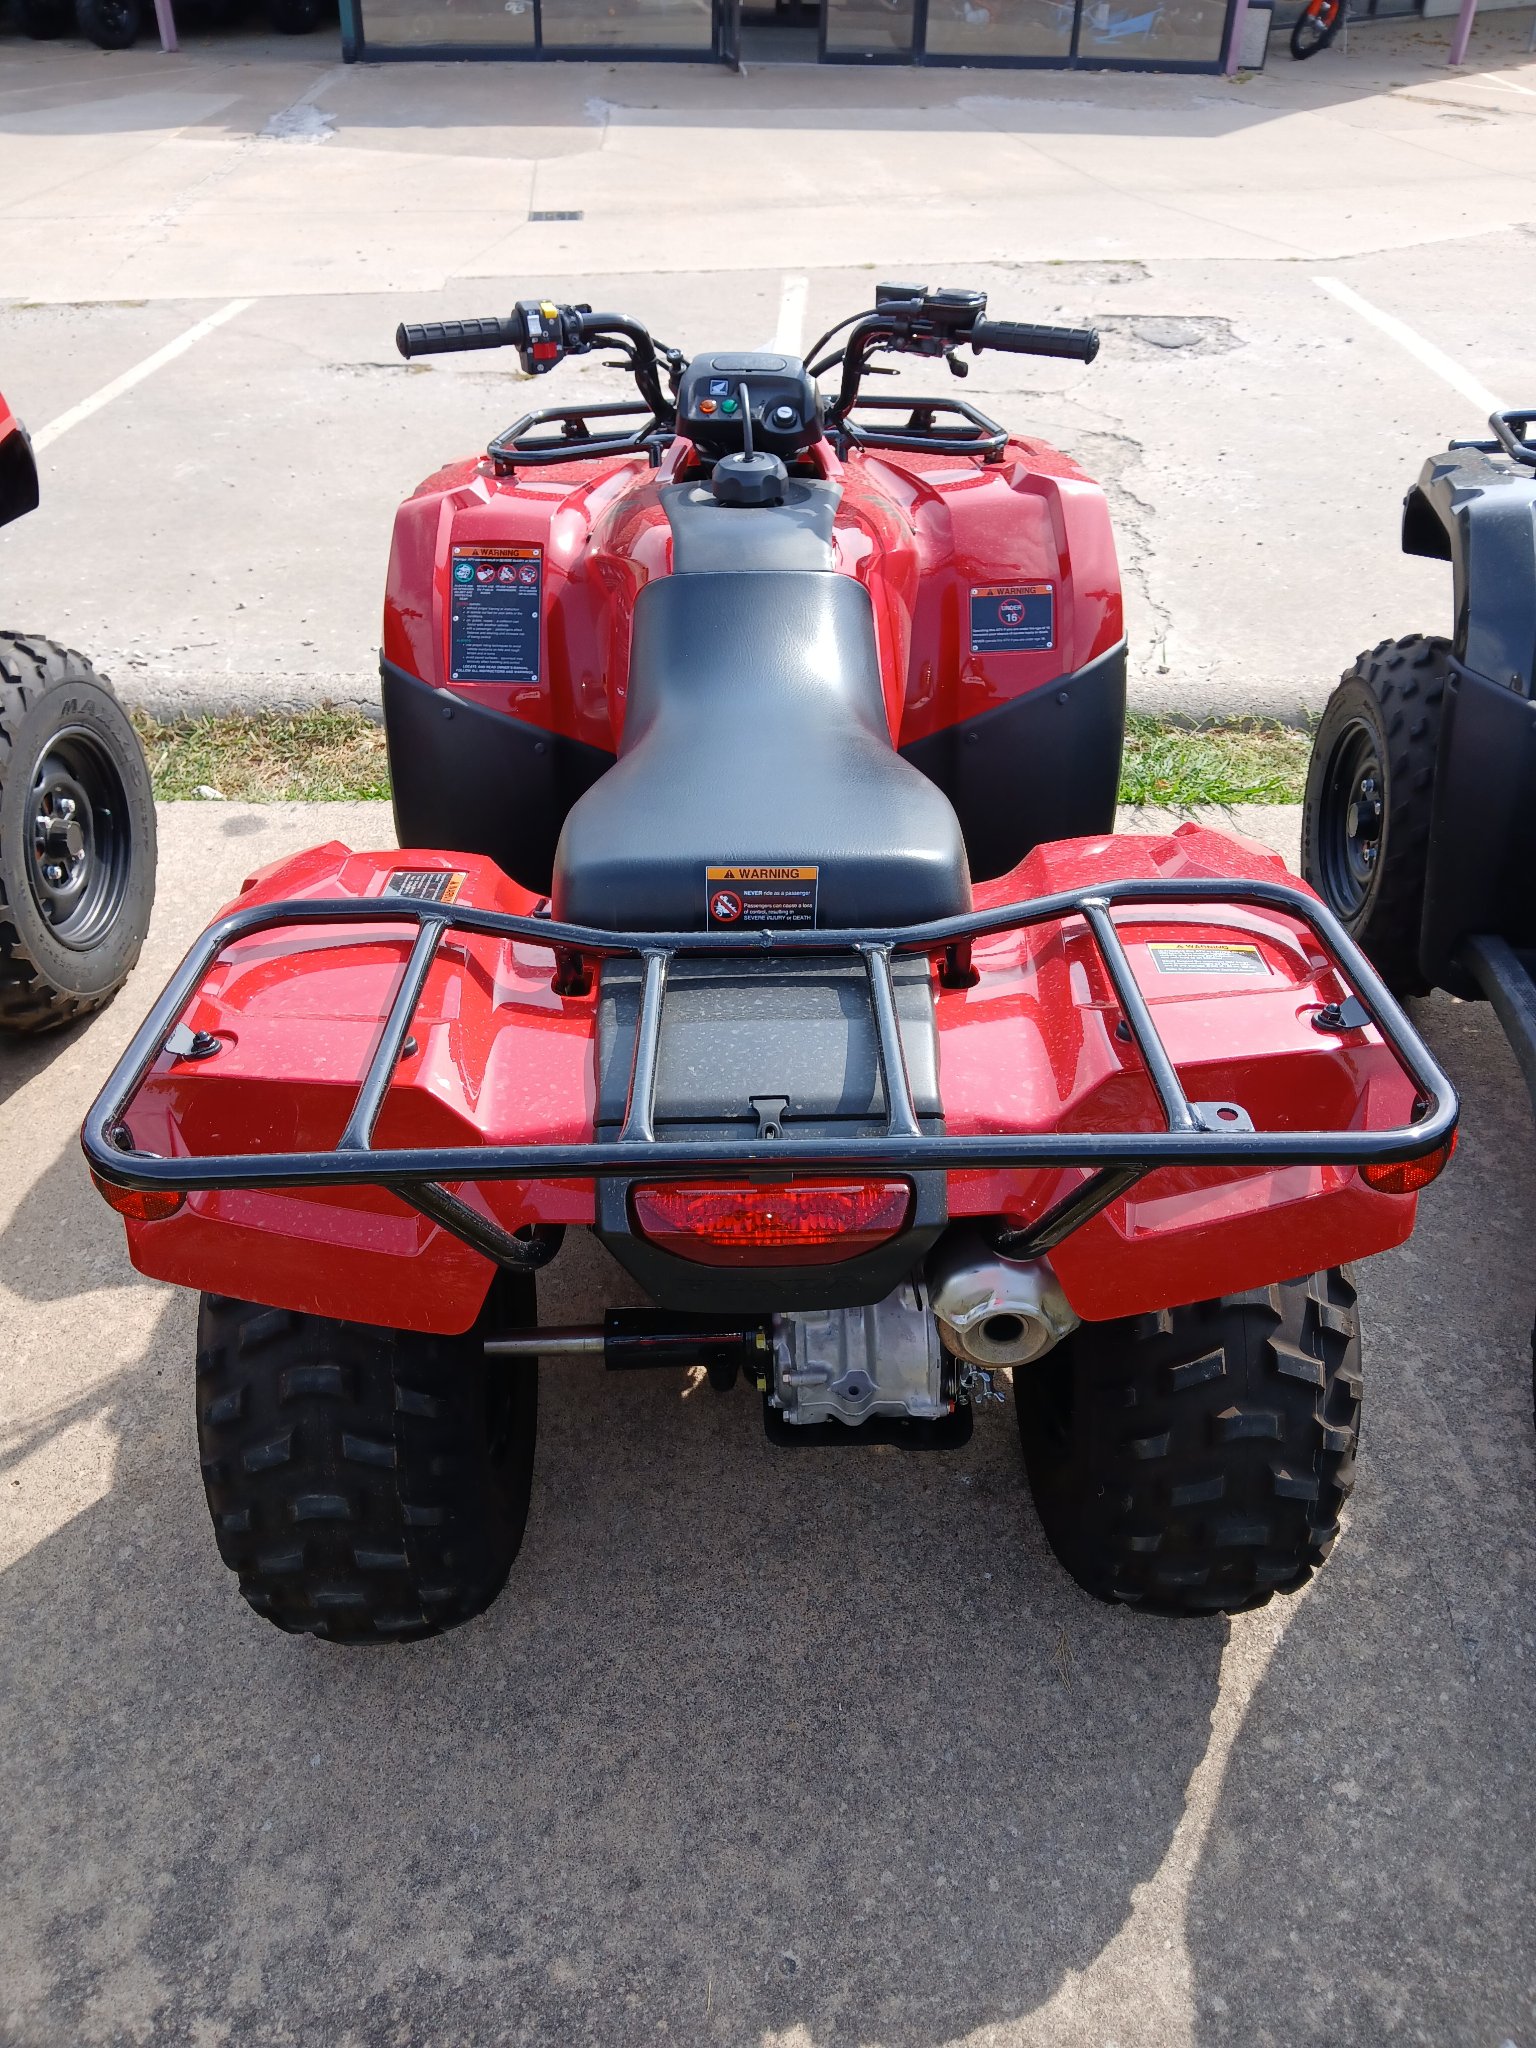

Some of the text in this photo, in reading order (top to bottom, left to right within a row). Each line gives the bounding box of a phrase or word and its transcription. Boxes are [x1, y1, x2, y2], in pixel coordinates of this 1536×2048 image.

[480, 548, 519, 556] WARNING
[997, 587, 1036, 595] WARNING
[1006, 613, 1018, 622] 16
[739, 868, 800, 879] WARNING
